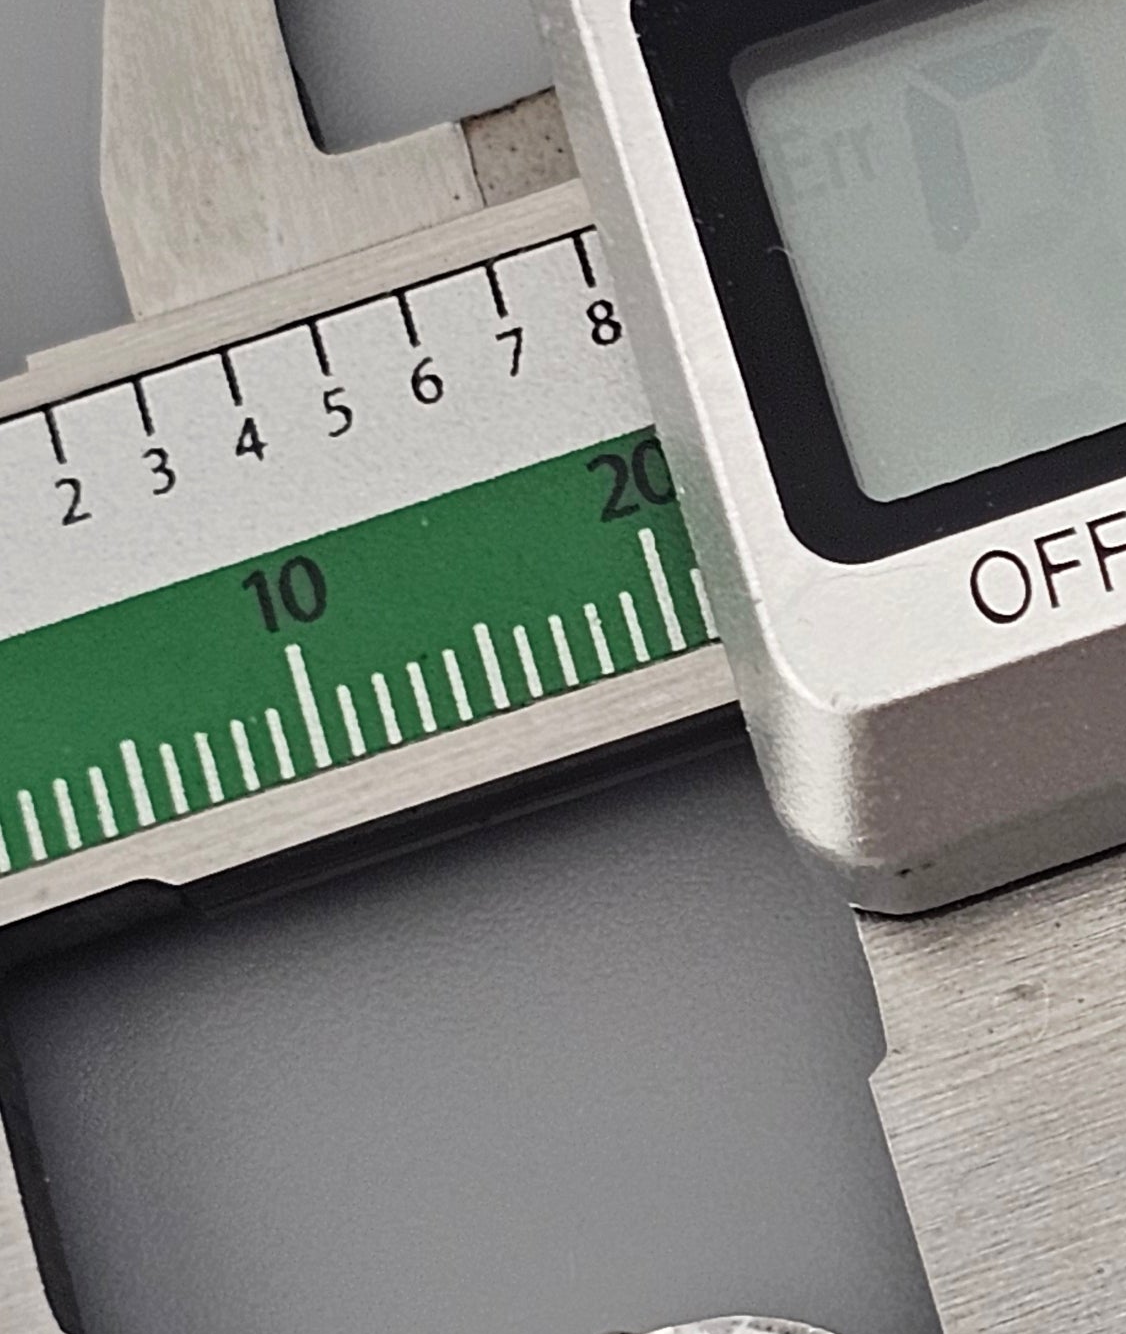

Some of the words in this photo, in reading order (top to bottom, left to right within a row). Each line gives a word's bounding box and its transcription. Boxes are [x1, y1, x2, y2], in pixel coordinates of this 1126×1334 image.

[54, 477, 92, 526] 2
[143, 447, 176, 495] 3
[235, 417, 268, 462] 4
[323, 388, 354, 438] 5
[410, 356, 445, 405] 6
[496, 327, 526, 377] 7
[586, 299, 622, 346] 8
[241, 555, 329, 634] 10
[586, 438, 681, 524] 20
